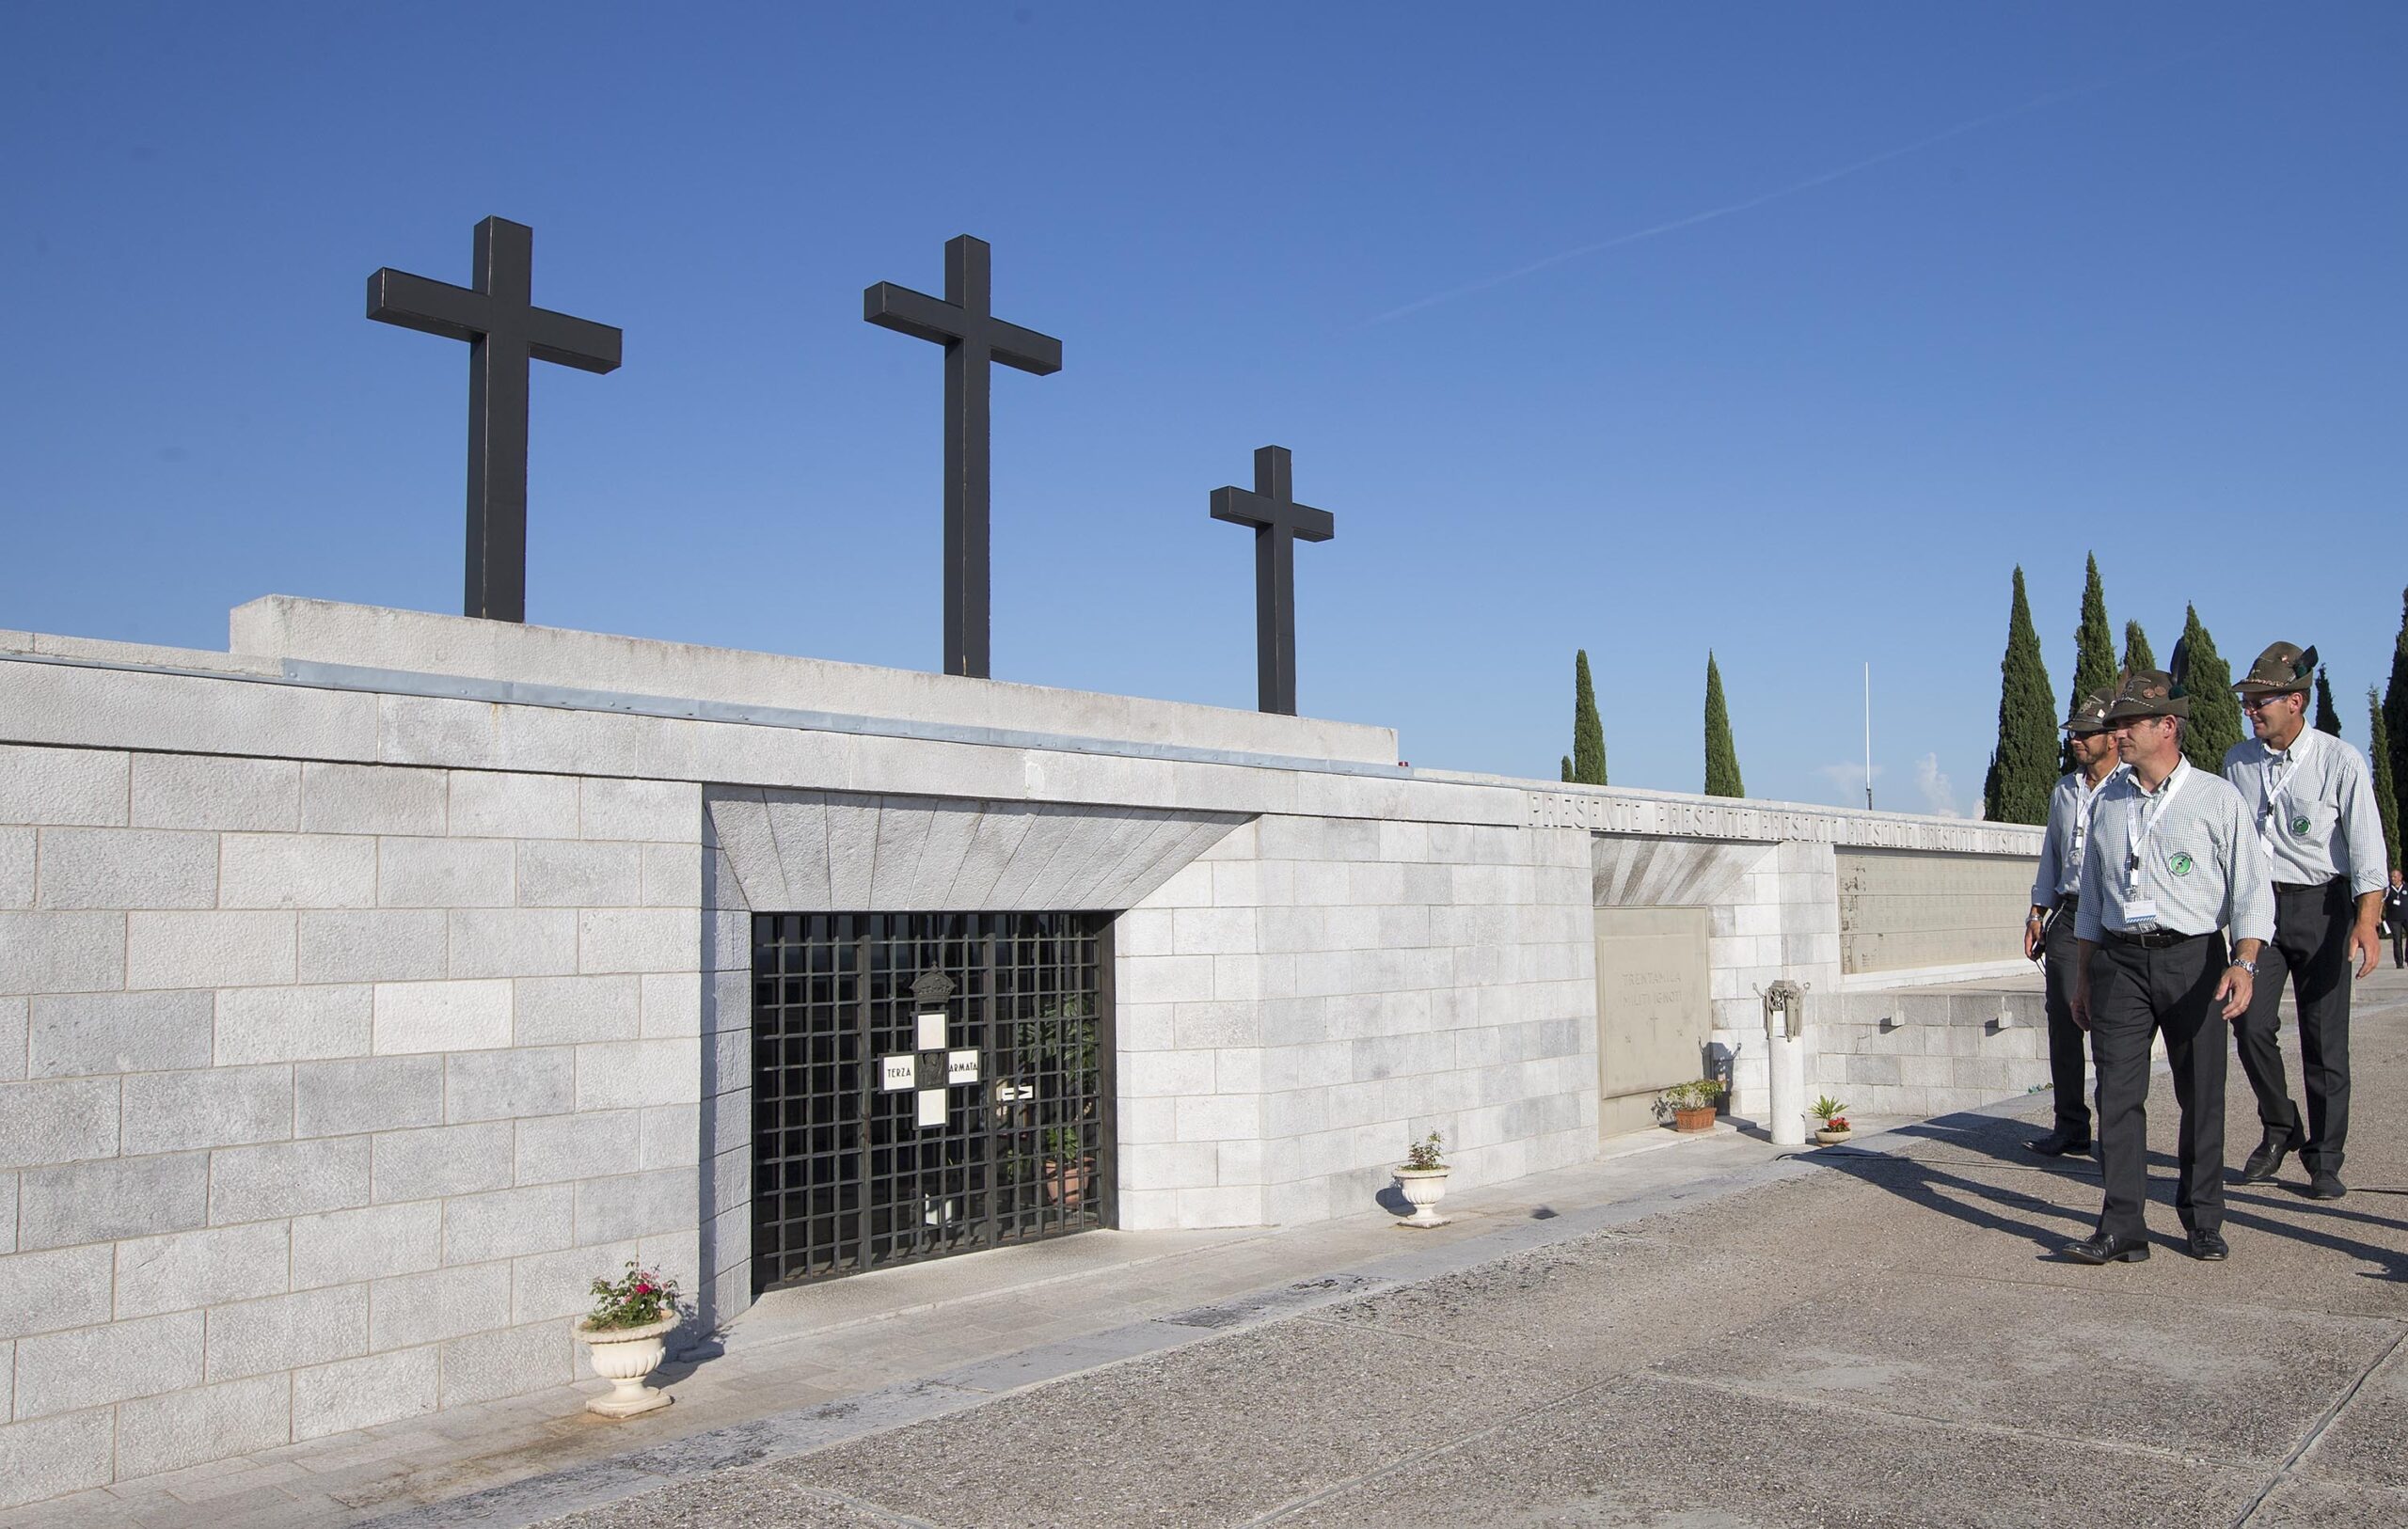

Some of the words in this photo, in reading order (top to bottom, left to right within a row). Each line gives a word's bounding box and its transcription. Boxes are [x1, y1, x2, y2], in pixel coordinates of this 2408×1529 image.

[1527, 794, 1642, 832] PRESENTE
[1656, 806, 1750, 838] PRESENTE
[1760, 813, 1838, 843] PRESENTE
[1846, 821, 1912, 847] PRESENTE
[1920, 828, 1976, 851] PRESENTE
[1622, 971, 1682, 986] TRENTAMILA
[1654, 989, 1683, 1004] IGNOTI
[887, 1066, 911, 1079] TERZA
[949, 1062, 978, 1073] ARMATA
